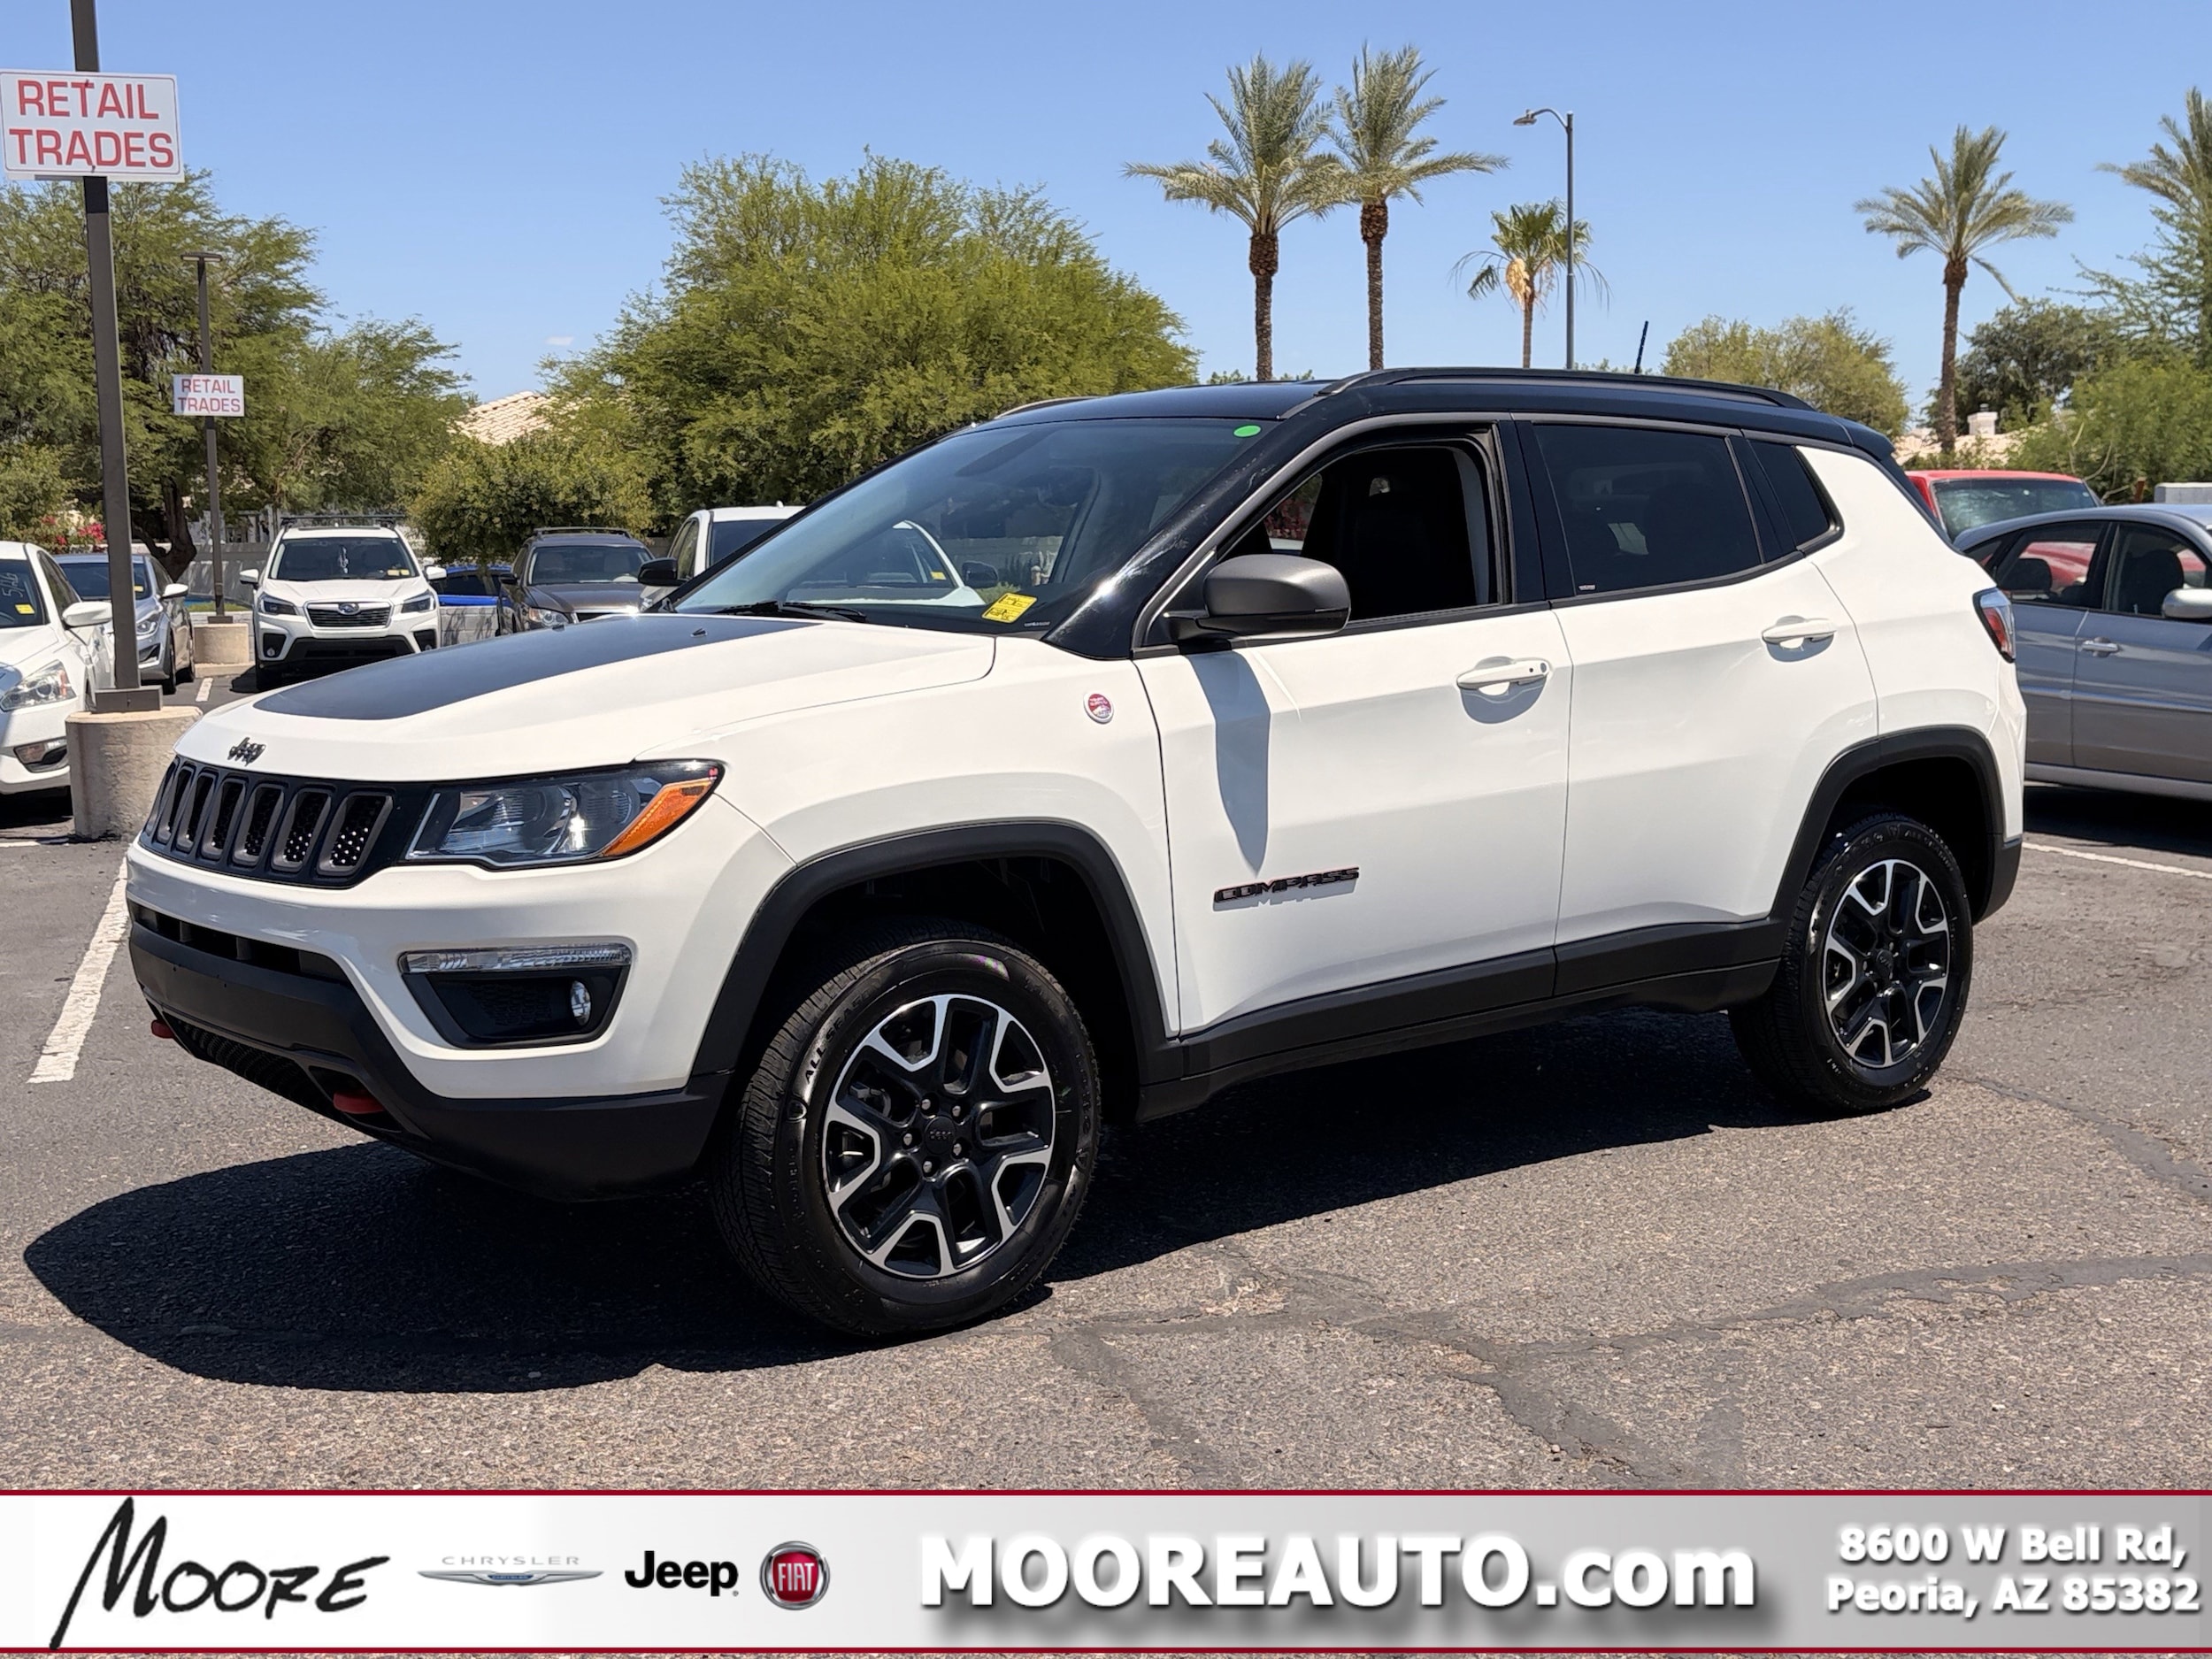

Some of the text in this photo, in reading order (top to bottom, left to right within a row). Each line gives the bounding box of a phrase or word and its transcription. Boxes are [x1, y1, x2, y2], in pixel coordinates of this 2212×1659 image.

[17, 79, 159, 120] RETAIL
[9, 127, 174, 168] TRADES
[178, 397, 241, 413] TRADES
[181, 379, 235, 394] RETAIL
[1214, 866, 1360, 903] COMPASS
